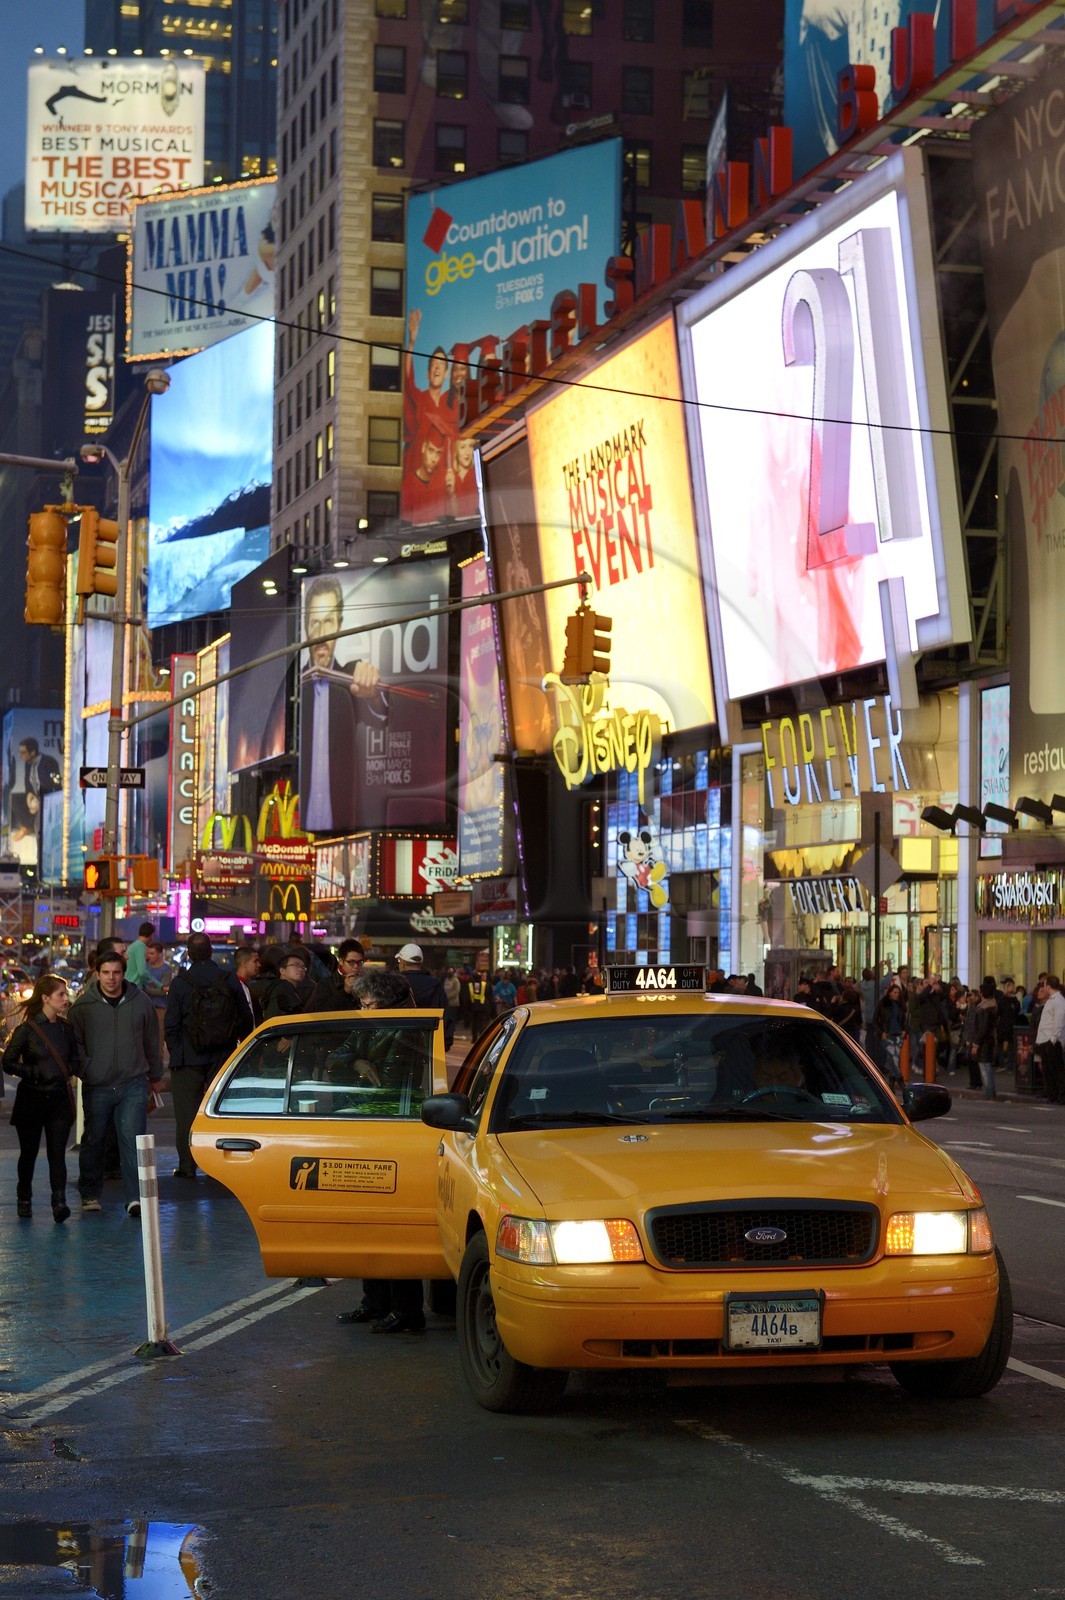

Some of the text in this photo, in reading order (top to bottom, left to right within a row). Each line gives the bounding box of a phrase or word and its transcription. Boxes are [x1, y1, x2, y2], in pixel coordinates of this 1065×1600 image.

[42, 124, 91, 134] WINNER
[106, 124, 138, 134] TONY
[141, 124, 193, 135] AWARDS
[42, 137, 192, 153] BEST MUSICAL
[112, 157, 192, 180] BEST
[41, 181, 143, 198] MUSICAL
[41, 201, 86, 215] THIS
[446, 196, 566, 245] Countdown to
[143, 206, 249, 272] MAMMA
[164, 263, 227, 324] MIA!
[496, 273, 544, 294] TUESDAYS
[514, 289, 535, 306] FOX
[535, 286, 544, 301] 5
[780, 227, 923, 571] 21
[562, 418, 647, 491] THE LANDMARK
[567, 446, 651, 533] MUSICAL
[572, 484, 655, 600] EVENT
[179, 670, 196, 825] PALACE
[389, 740, 411, 749] FINALE
[760, 695, 910, 808] FOREVER
[366, 760, 386, 770] MON
[387, 759, 402, 770] MAY
[91, 774, 105, 783] ON
[384, 770, 402, 784] FOX
[403, 769, 411, 783] 5
[257, 843, 315, 855] McDonald's
[788, 879, 849, 915] FOREVER
[848, 878, 866, 912] 21
[994, 880, 1055, 907] SWAROVSKI
[613, 969, 629, 979] OFF
[635, 967, 677, 989] 4A64
[682, 968, 697, 977] OFF
[612, 980, 631, 990] DUTY
[681, 979, 700, 989] DUTY
[755, 1231, 777, 1240] Ford
[751, 1303, 797, 1314] NEW YORK
[751, 1313, 798, 1337] 4A64B
